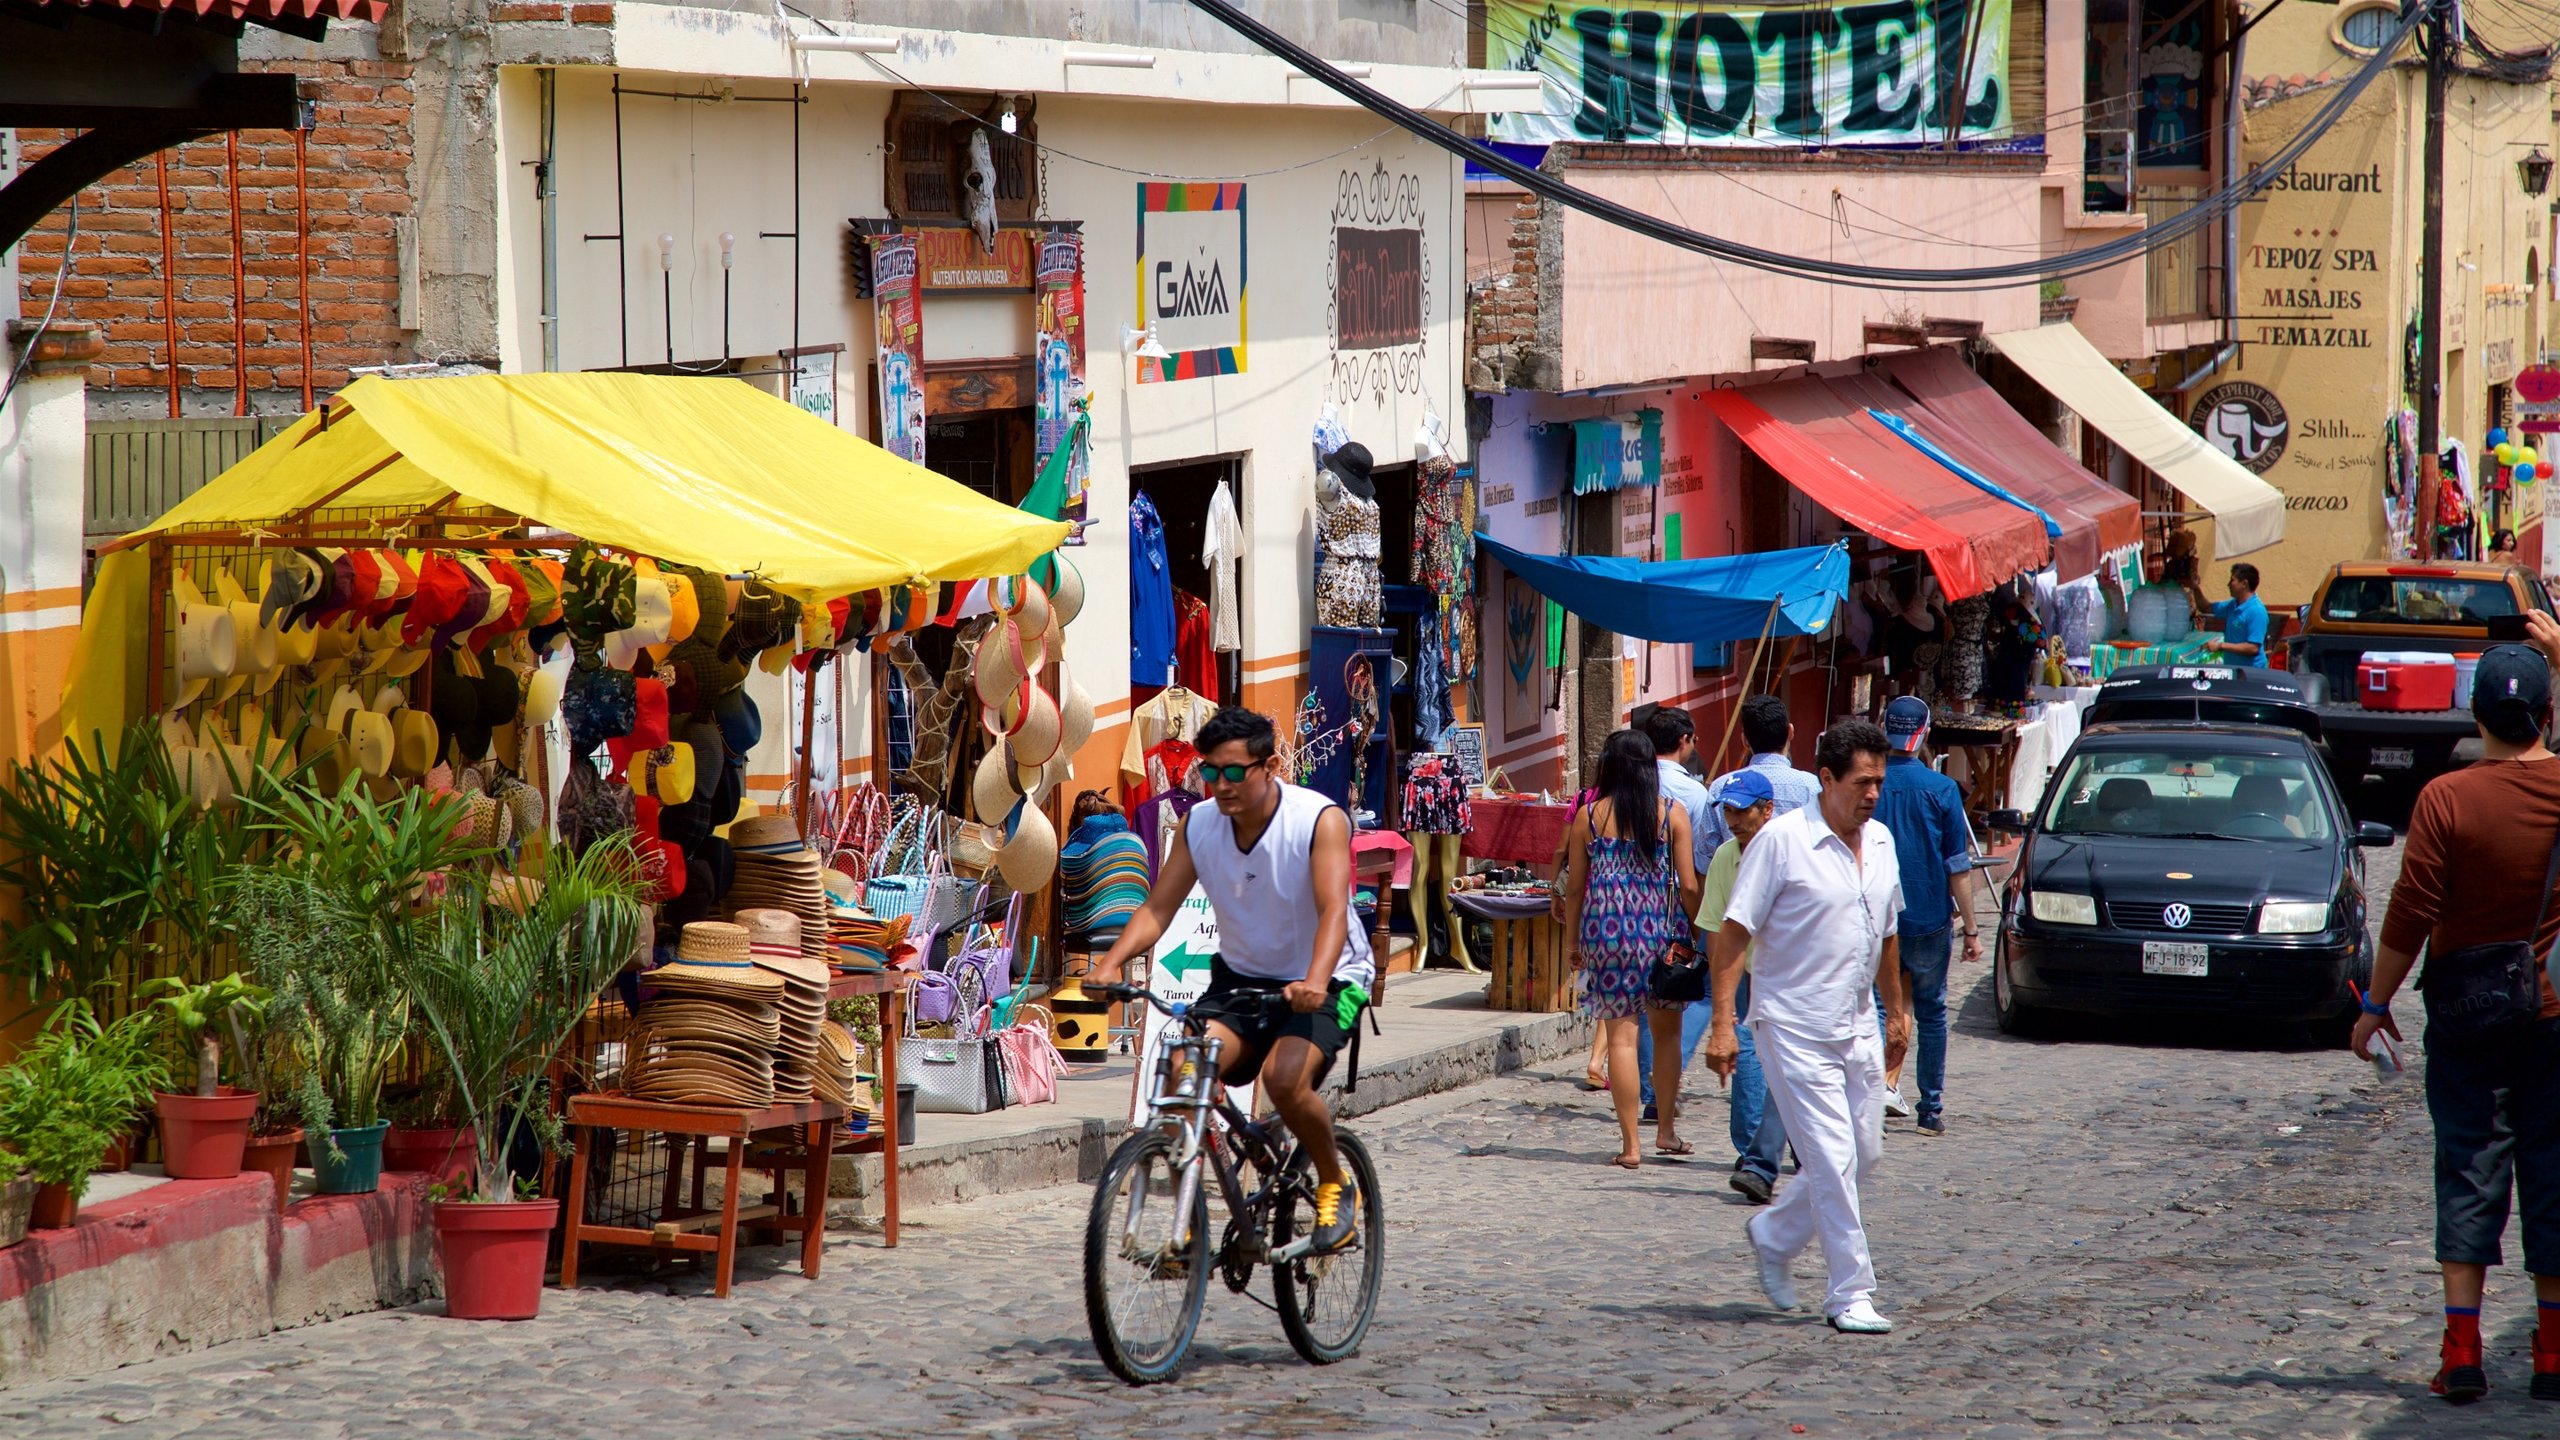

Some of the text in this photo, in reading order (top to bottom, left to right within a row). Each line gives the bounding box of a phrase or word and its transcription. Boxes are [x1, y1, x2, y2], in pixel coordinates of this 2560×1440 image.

[1575, 0, 1998, 137] HOTEL
[2247, 245, 2379, 271] TEPOZ SPA
[933, 269, 1009, 285] AUTENTICA ROPA VAQUERA
[2261, 288, 2362, 310] MASAJES
[2257, 326, 2372, 348] TEMAZCAL
[794, 386, 832, 417] Masajes
[2207, 383, 2261, 408] ELEPHANT
[2294, 451, 2321, 470] Sigue
[2325, 458, 2335, 471] el
[2280, 489, 2348, 511] uencos
[2145, 951, 2206, 967] MFJ-18-92
[1163, 989, 1194, 1000] Tarot
